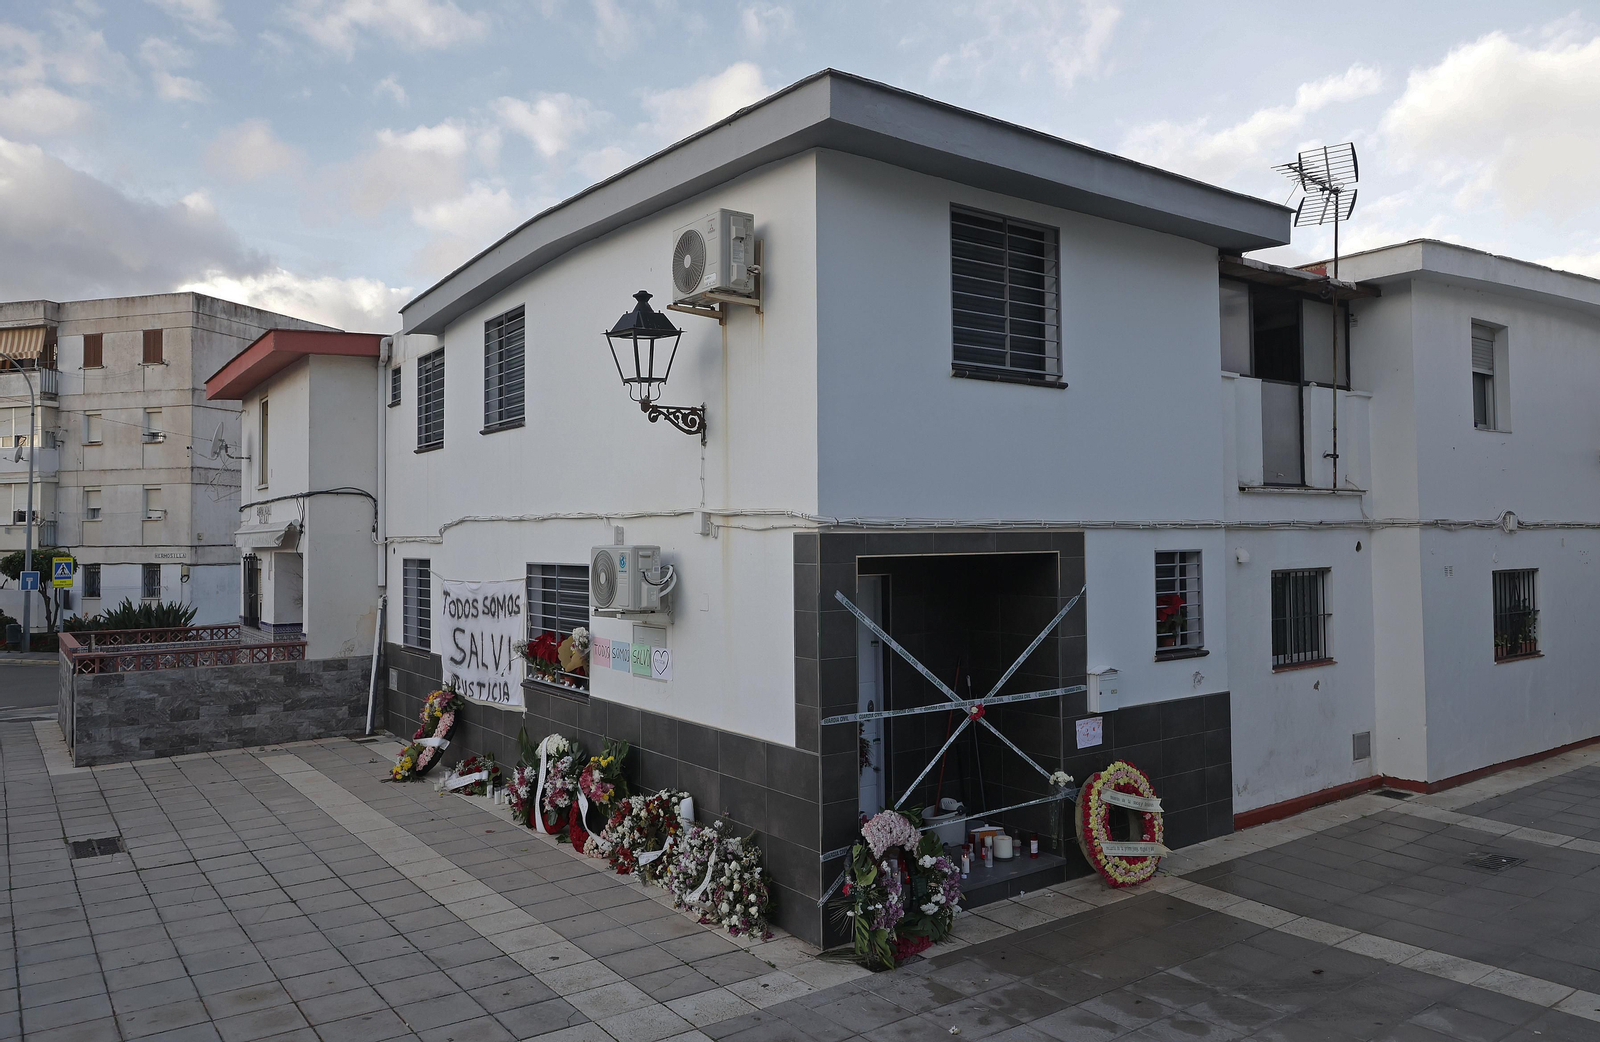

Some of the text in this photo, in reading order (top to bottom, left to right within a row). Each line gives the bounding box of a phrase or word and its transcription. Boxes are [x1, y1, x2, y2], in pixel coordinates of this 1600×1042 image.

[443, 590, 520, 620] TODOS SOMOS
[450, 627, 512, 672] SALVI
[594, 644, 610, 659] TODOS
[612, 648, 630, 662] SOMOS
[632, 650, 650, 666] SALVI
